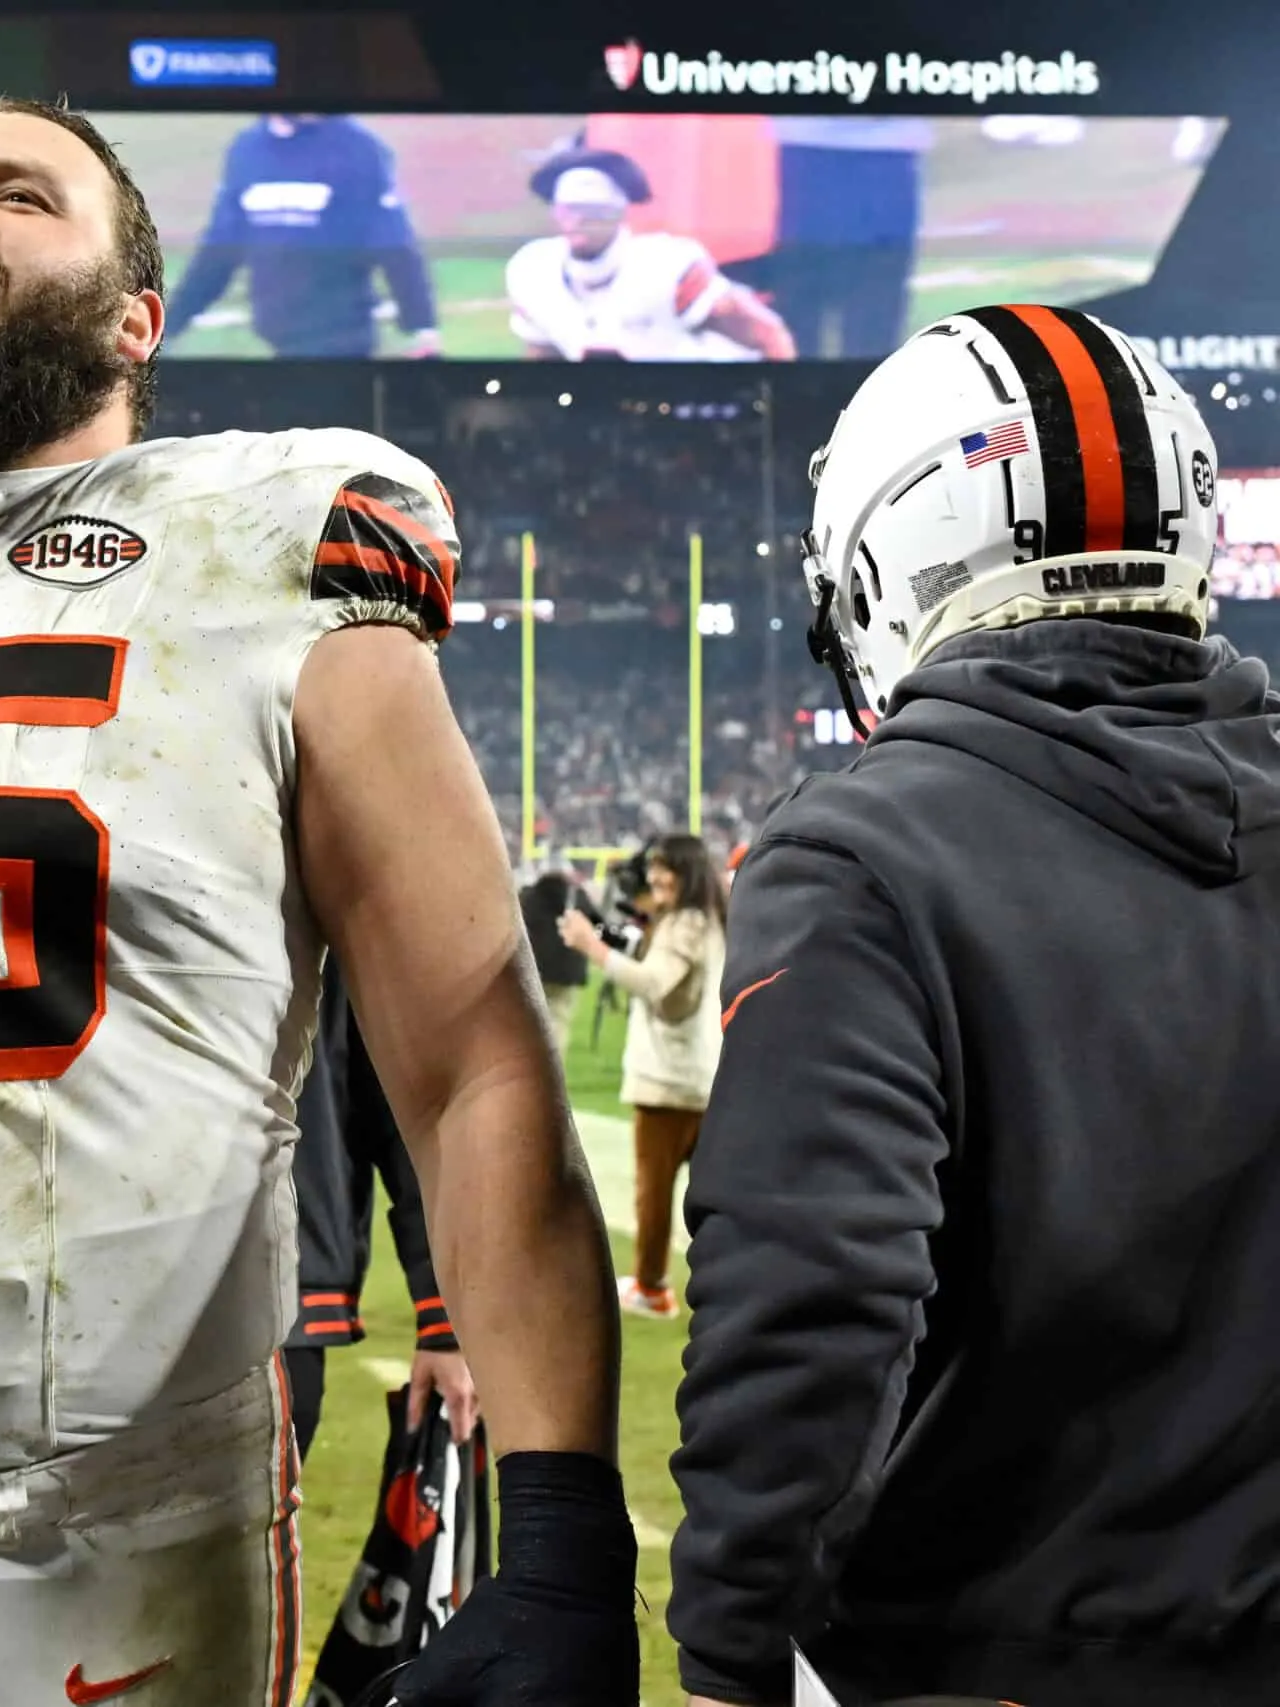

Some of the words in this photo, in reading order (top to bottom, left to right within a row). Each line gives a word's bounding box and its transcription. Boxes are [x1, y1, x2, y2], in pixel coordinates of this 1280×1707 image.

[642, 50, 878, 103] University
[885, 50, 1099, 103] Hospitals
[1194, 460, 1213, 497] 32
[34, 533, 119, 569] 1946
[1041, 562, 1166, 595] CLEVELAND
